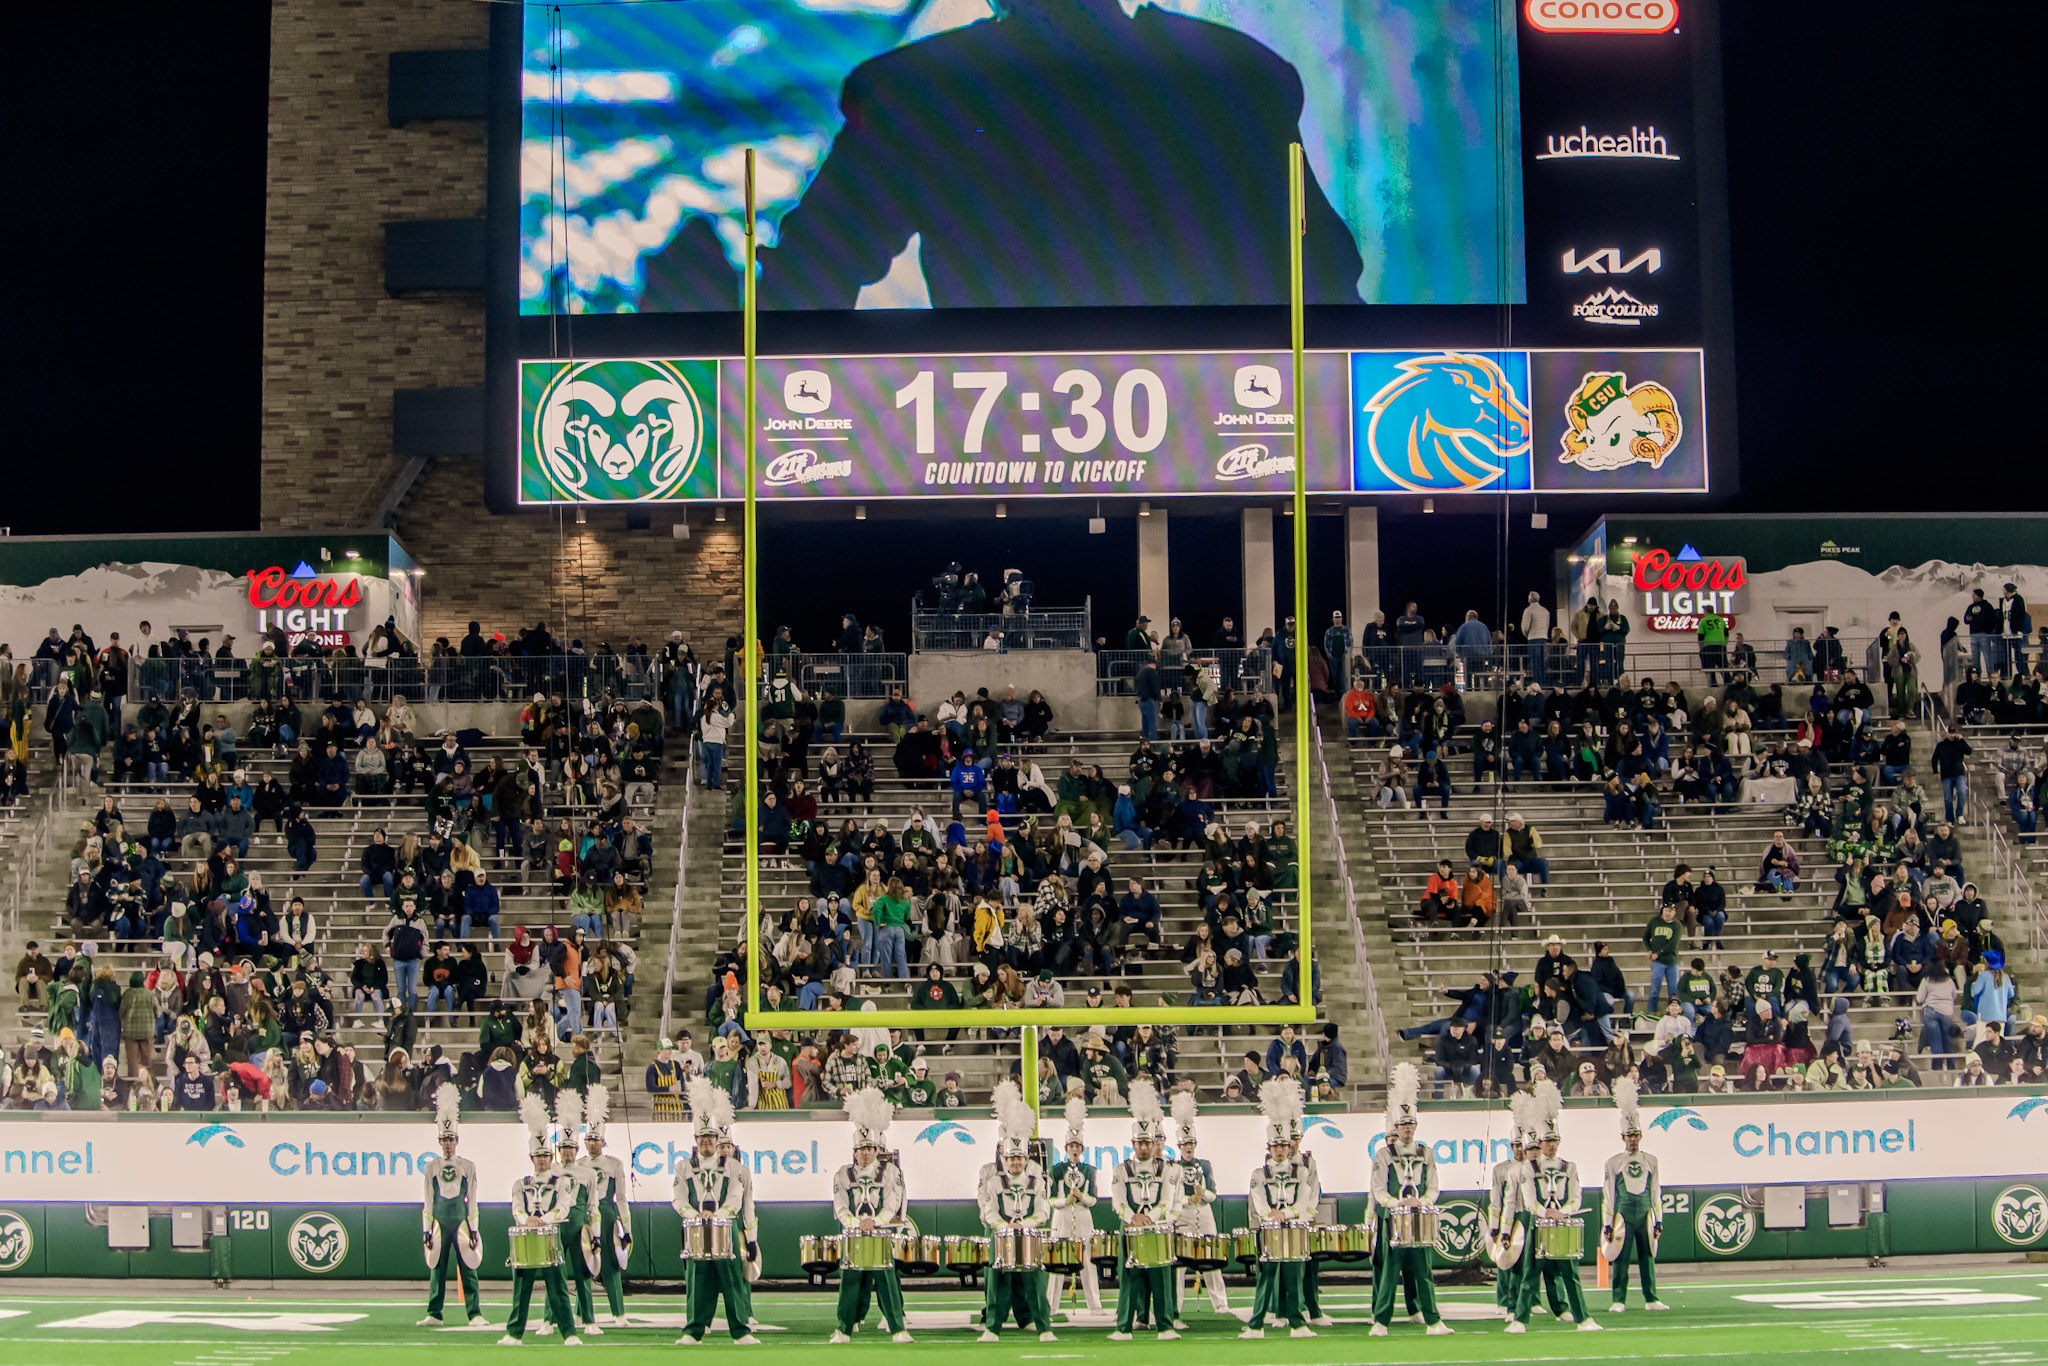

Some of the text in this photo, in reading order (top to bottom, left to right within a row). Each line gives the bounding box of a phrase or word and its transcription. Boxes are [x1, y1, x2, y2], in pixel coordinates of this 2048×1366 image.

[1540, 2, 1664, 20] conoco
[1548, 126, 1668, 156] uchealth
[1563, 248, 1662, 274] KIA
[1573, 304, 1659, 317] FORT COLLINS
[1588, 384, 1617, 411] CSU
[763, 417, 853, 430] JOHN DEERE
[896, 368, 1168, 454] 17:30
[1213, 412, 1295, 425] JOHN DEER
[924, 460, 1147, 485] COUNTDOWN TO KICKOFF
[1631, 548, 1747, 591] Coors
[247, 566, 362, 608] Coors
[1645, 591, 1735, 615] LIGHT
[259, 608, 349, 633] LIGHT
[1653, 615, 1690, 630] Chill
[306, 634, 343, 646] ONE
[775, 688, 786, 703] 31
[1754, 982, 1773, 993] CSU
[1732, 1118, 1915, 1158] Channel
[5, 1141, 93, 1174] nnel
[269, 1141, 439, 1176] Channe
[230, 1209, 270, 1230] 120
